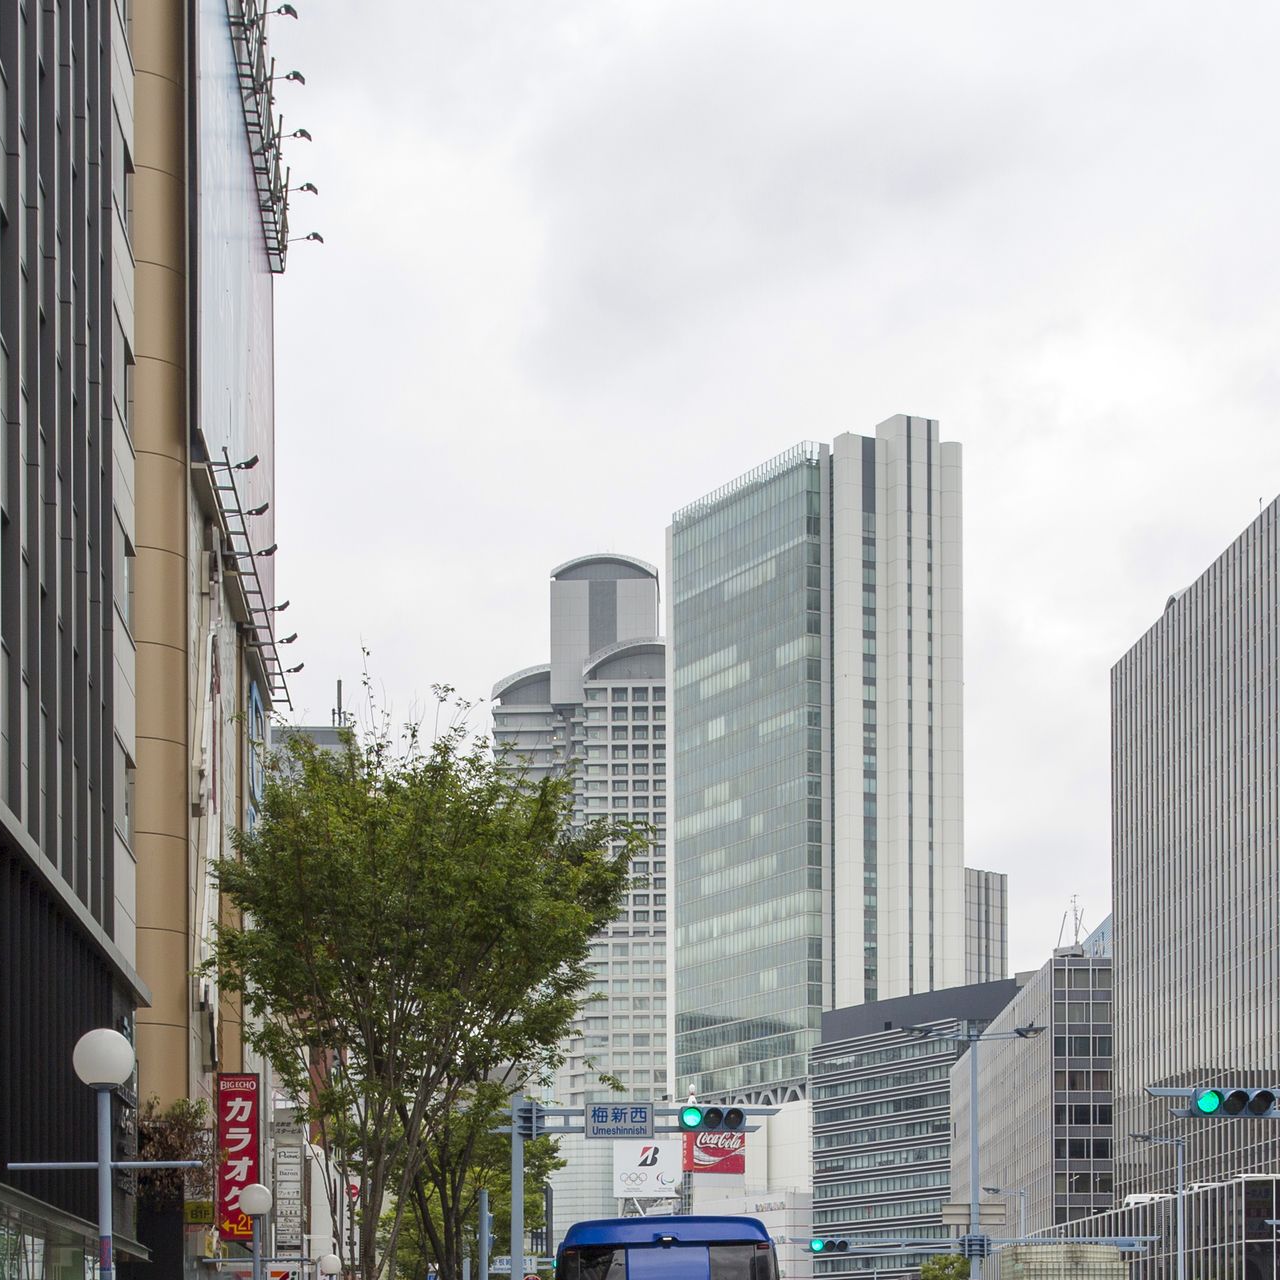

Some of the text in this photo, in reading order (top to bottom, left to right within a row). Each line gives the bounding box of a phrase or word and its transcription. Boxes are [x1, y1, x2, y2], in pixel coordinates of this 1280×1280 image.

[220, 1080, 257, 1091] BIG ECHO
[591, 1106, 648, 1124] 梅新西
[592, 1126, 647, 1135] Umeshinnishi
